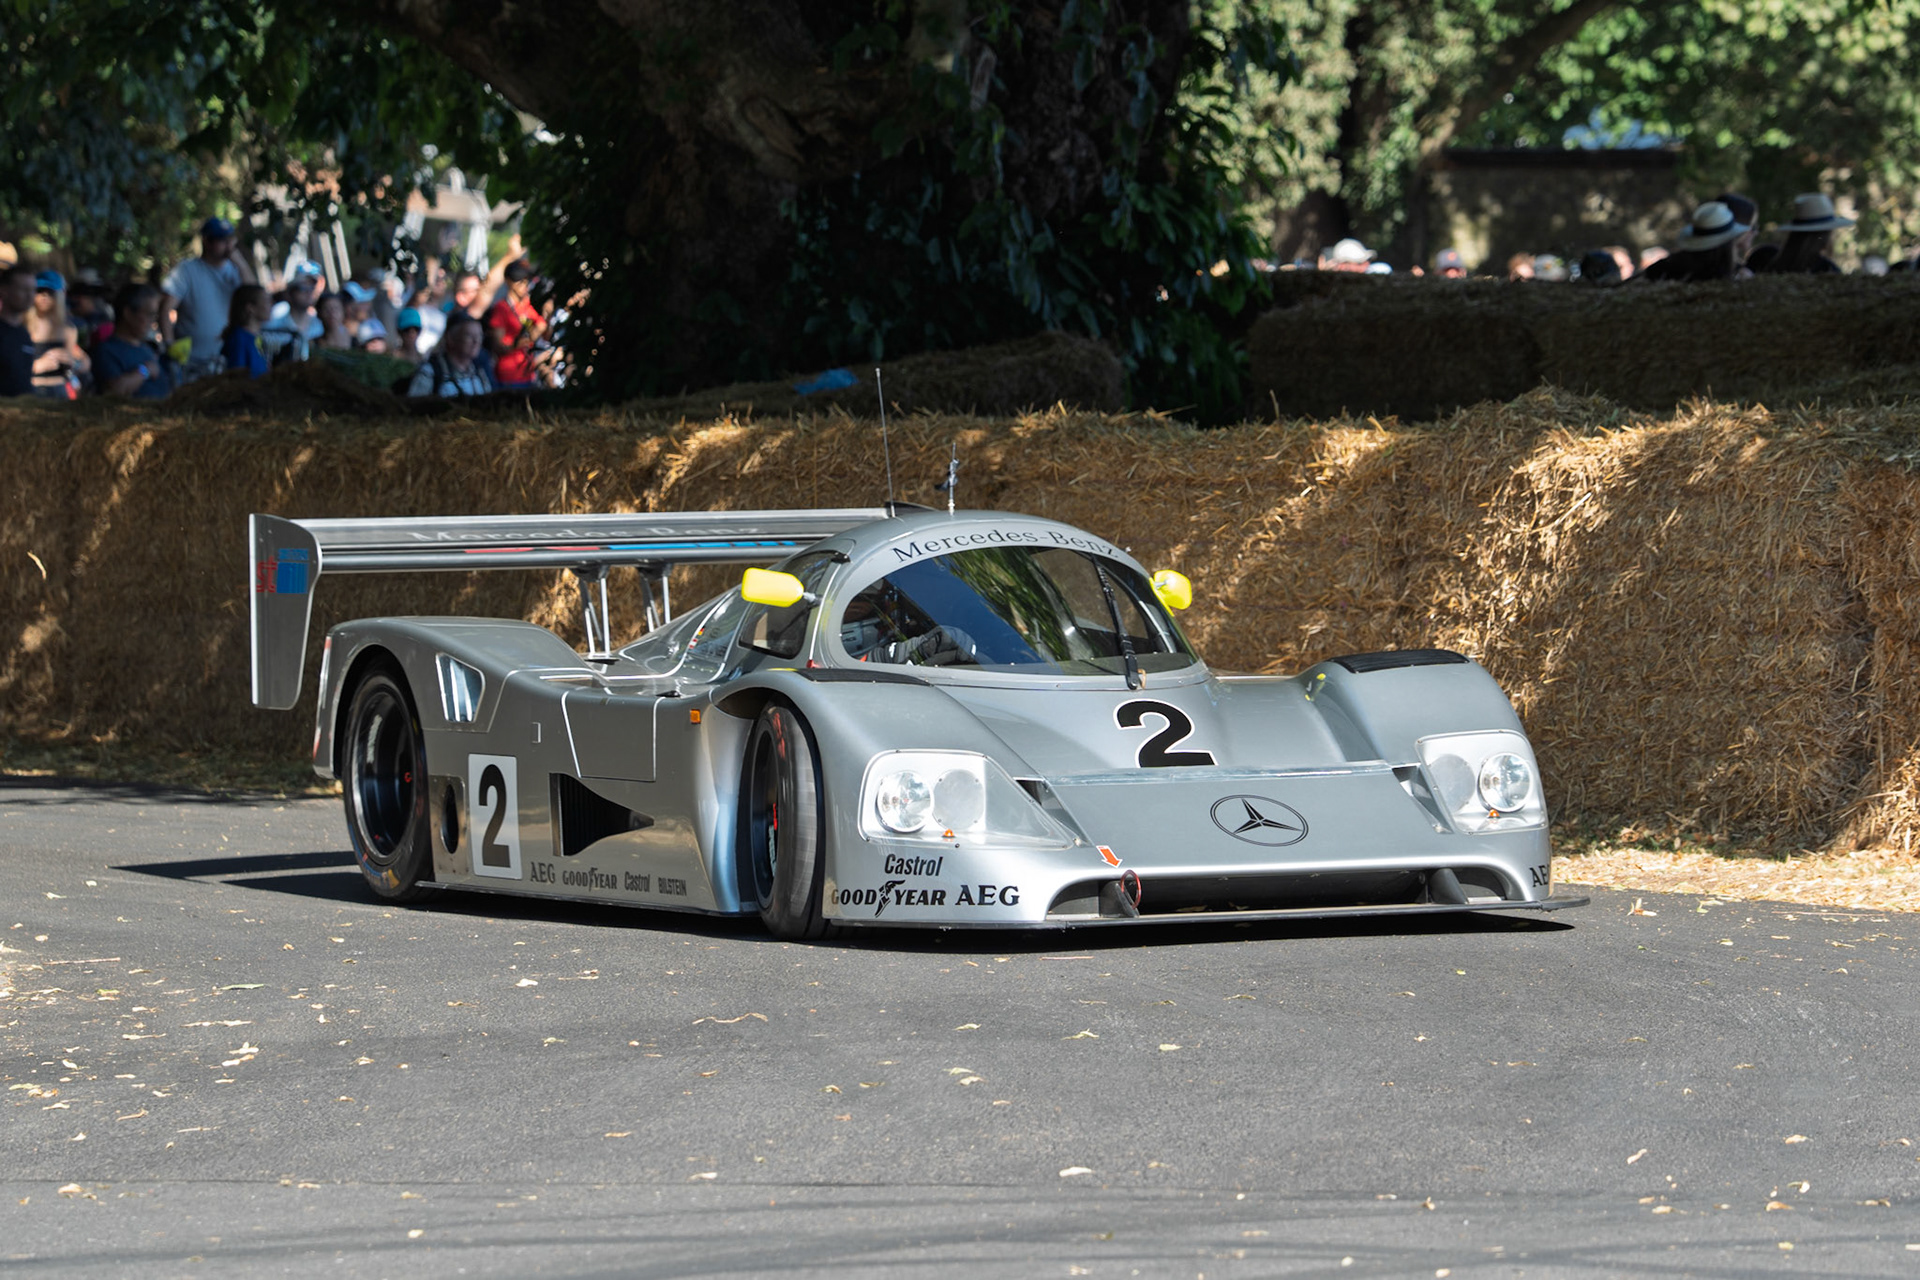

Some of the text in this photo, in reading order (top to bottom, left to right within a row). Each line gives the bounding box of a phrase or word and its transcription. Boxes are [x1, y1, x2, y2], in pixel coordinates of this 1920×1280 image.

[892, 529, 1120, 563] Mercedes-Benz
[1114, 699, 1217, 768] 2
[478, 764, 512, 869] 2
[530, 861, 688, 897] AEG GOODYEAR Castrol BILSTEIN
[884, 853, 943, 877] Castrol
[1529, 863, 1550, 888] AE
[831, 880, 1020, 918] GOODYEAR AEG
